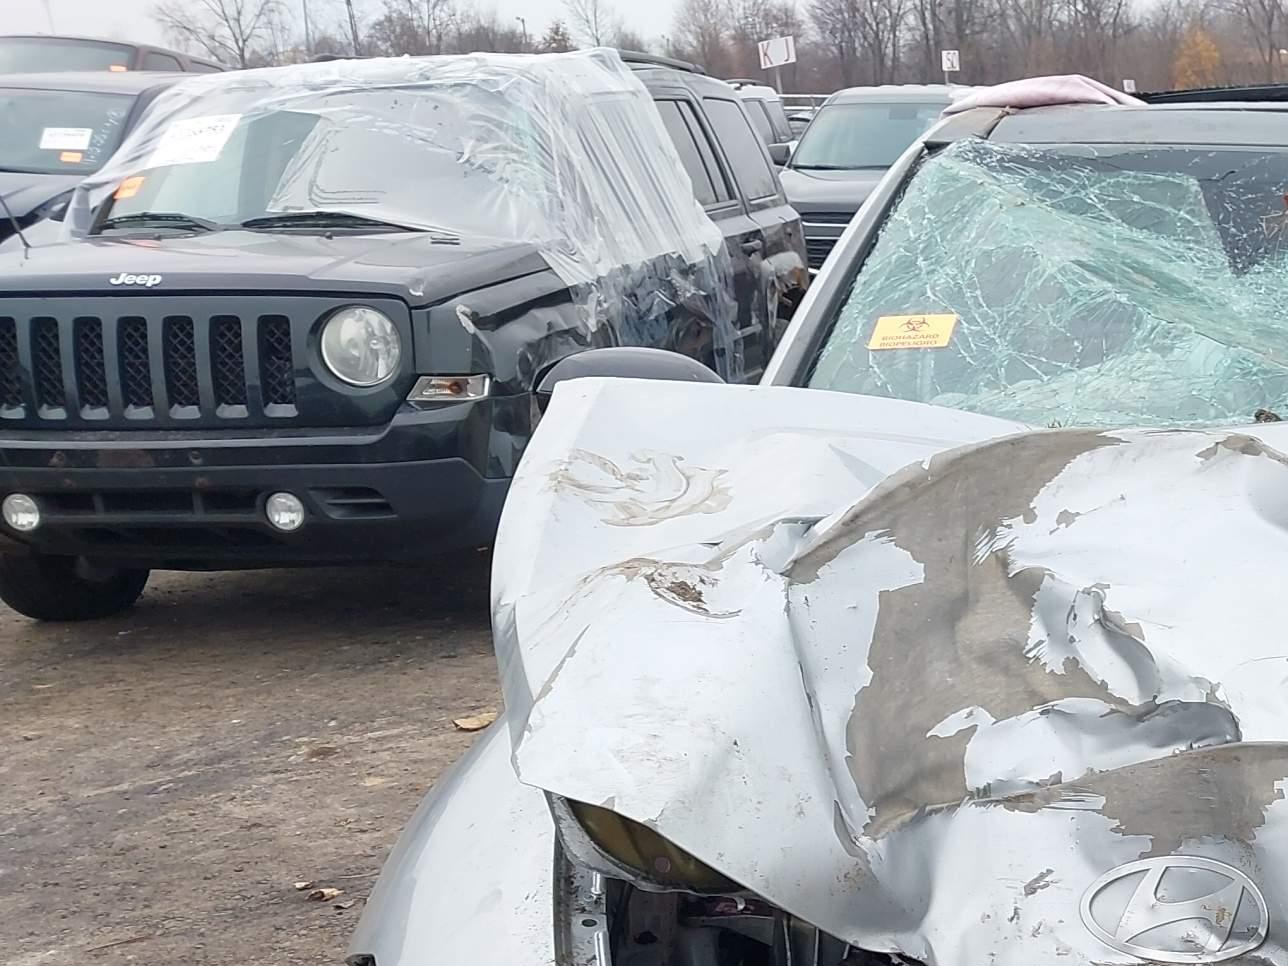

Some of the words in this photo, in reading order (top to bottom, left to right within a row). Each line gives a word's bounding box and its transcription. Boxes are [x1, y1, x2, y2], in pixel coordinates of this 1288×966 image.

[761, 41, 773, 67] K
[784, 38, 791, 62] J
[109, 272, 163, 288] Jeep
[881, 333, 940, 341] BIOHAZARD
